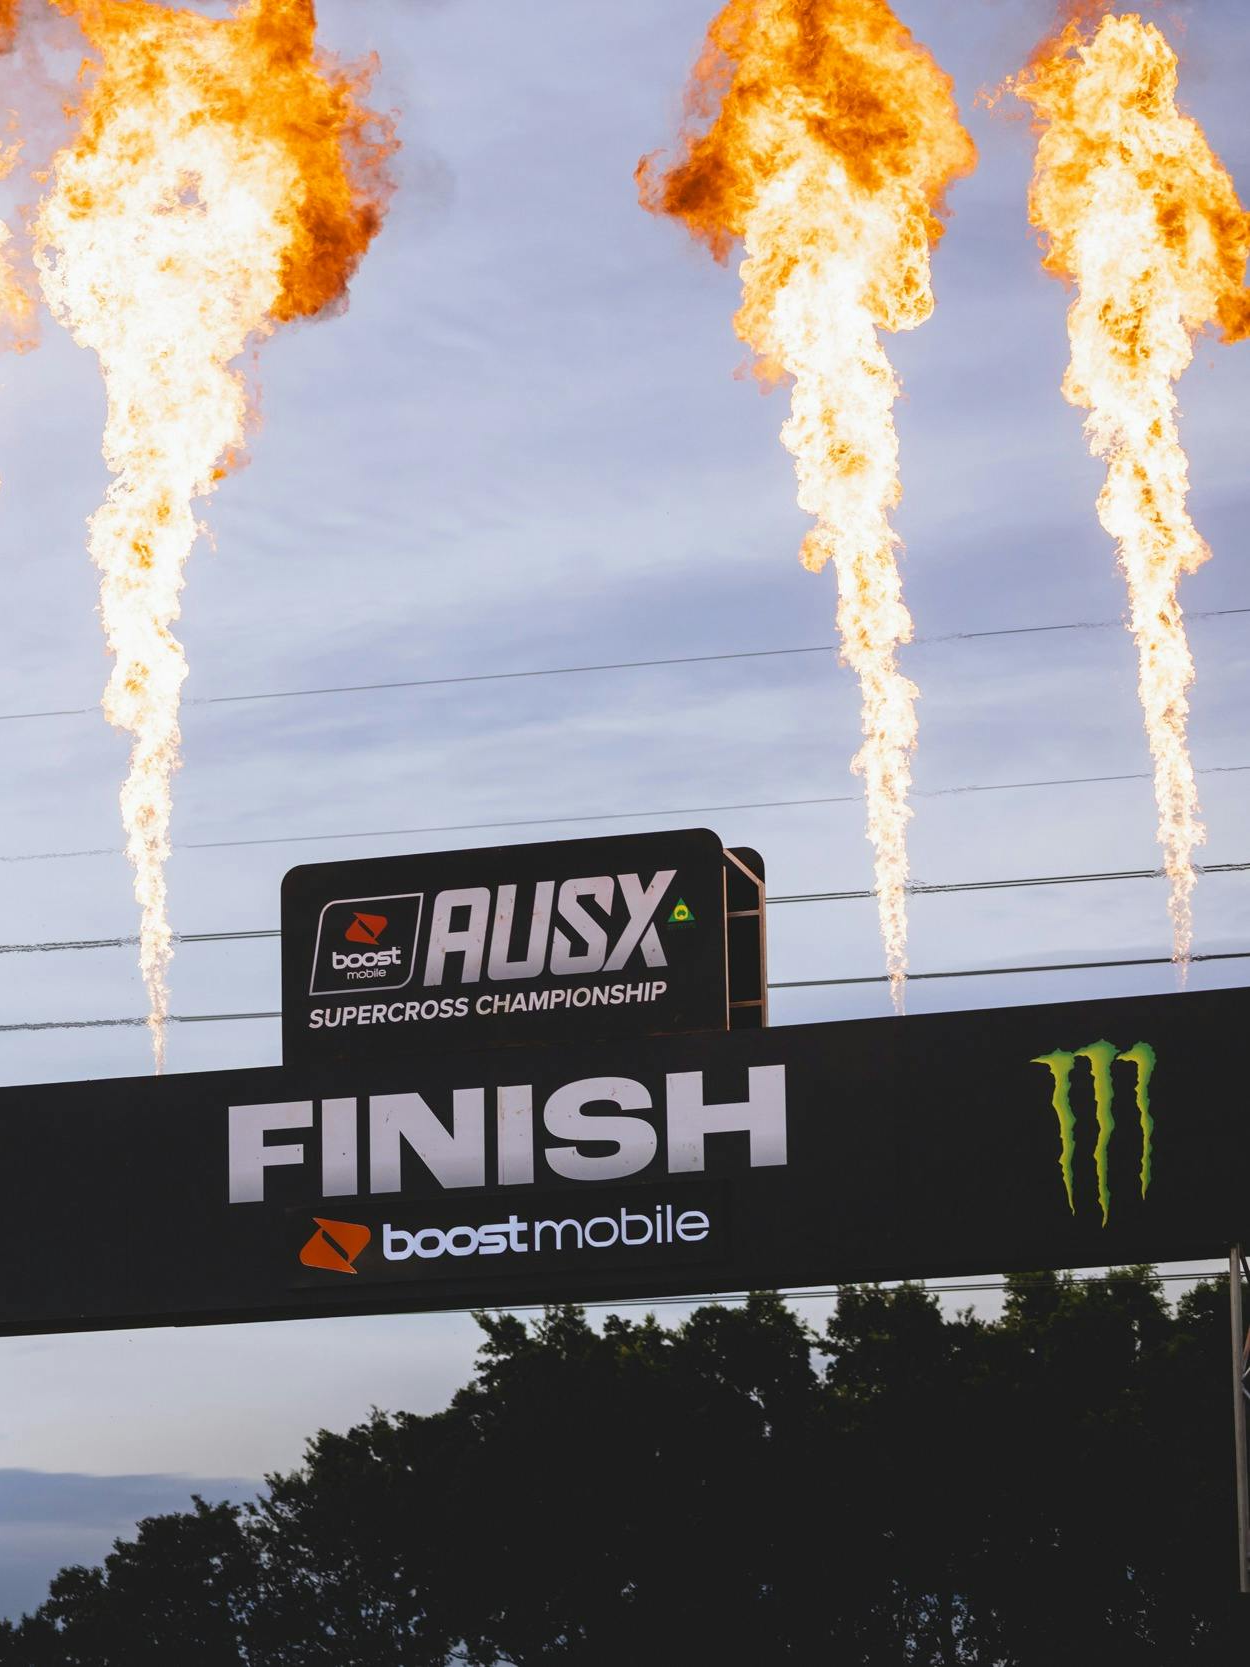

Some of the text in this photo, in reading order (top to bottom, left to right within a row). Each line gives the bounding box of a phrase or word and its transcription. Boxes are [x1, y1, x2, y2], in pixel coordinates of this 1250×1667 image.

[424, 870, 677, 987] AUSX
[332, 946, 402, 969] boost
[346, 968, 387, 980] mobile
[308, 980, 668, 1029] SUPERCROSS CHAMPIONSHIP
[229, 1065, 788, 1203] FINISH
